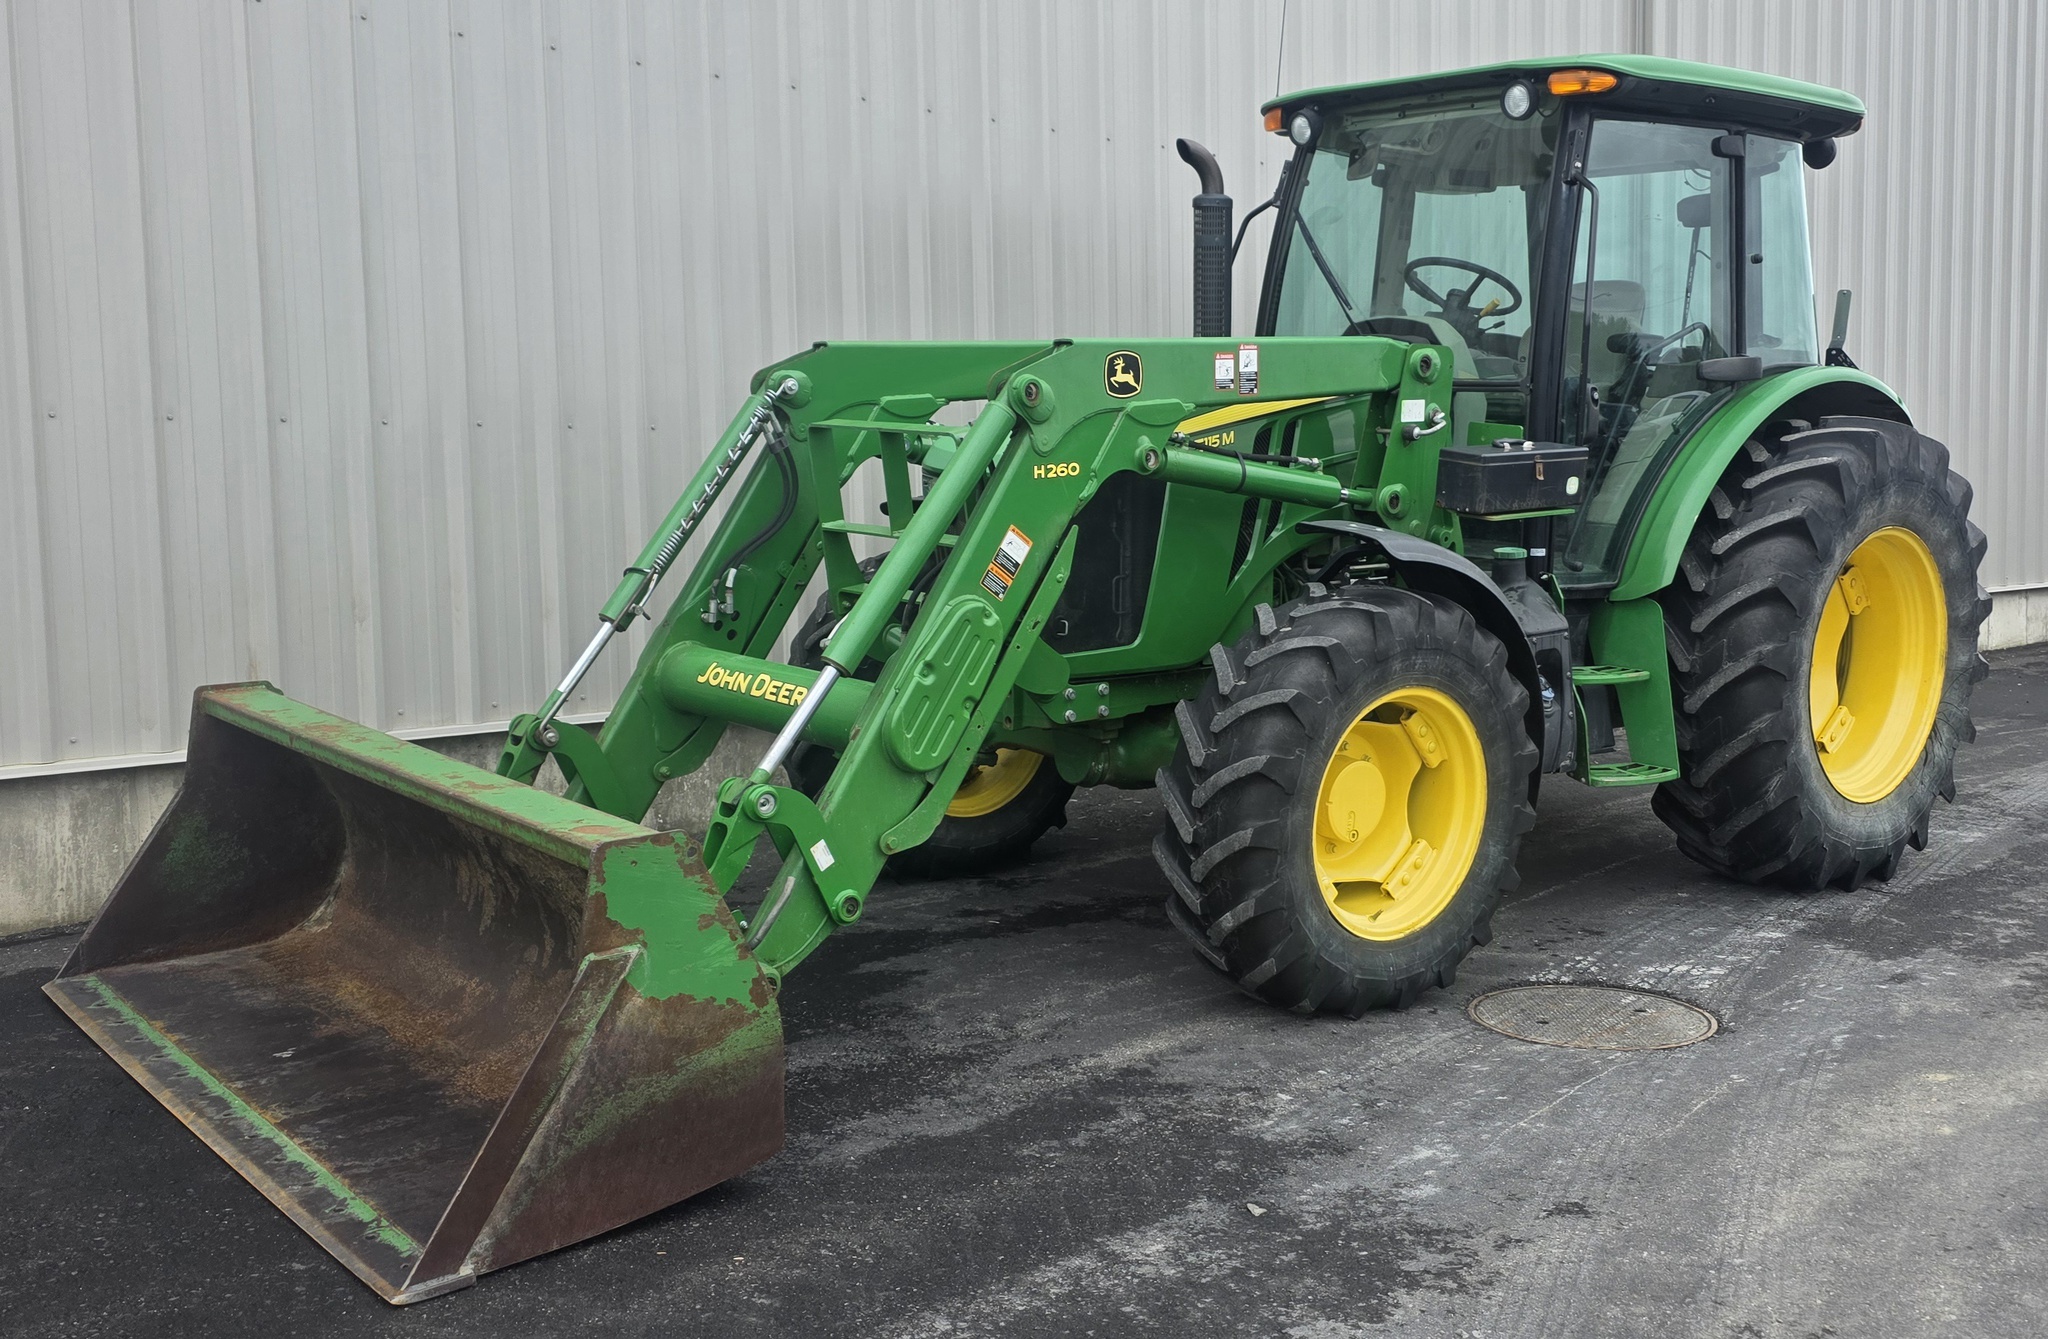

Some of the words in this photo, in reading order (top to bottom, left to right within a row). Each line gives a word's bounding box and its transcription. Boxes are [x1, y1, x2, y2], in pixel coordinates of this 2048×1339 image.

[1222, 430, 1235, 446] M
[1033, 462, 1080, 479] H260
[697, 662, 753, 694] JOHN
[750, 673, 809, 706] DEER
